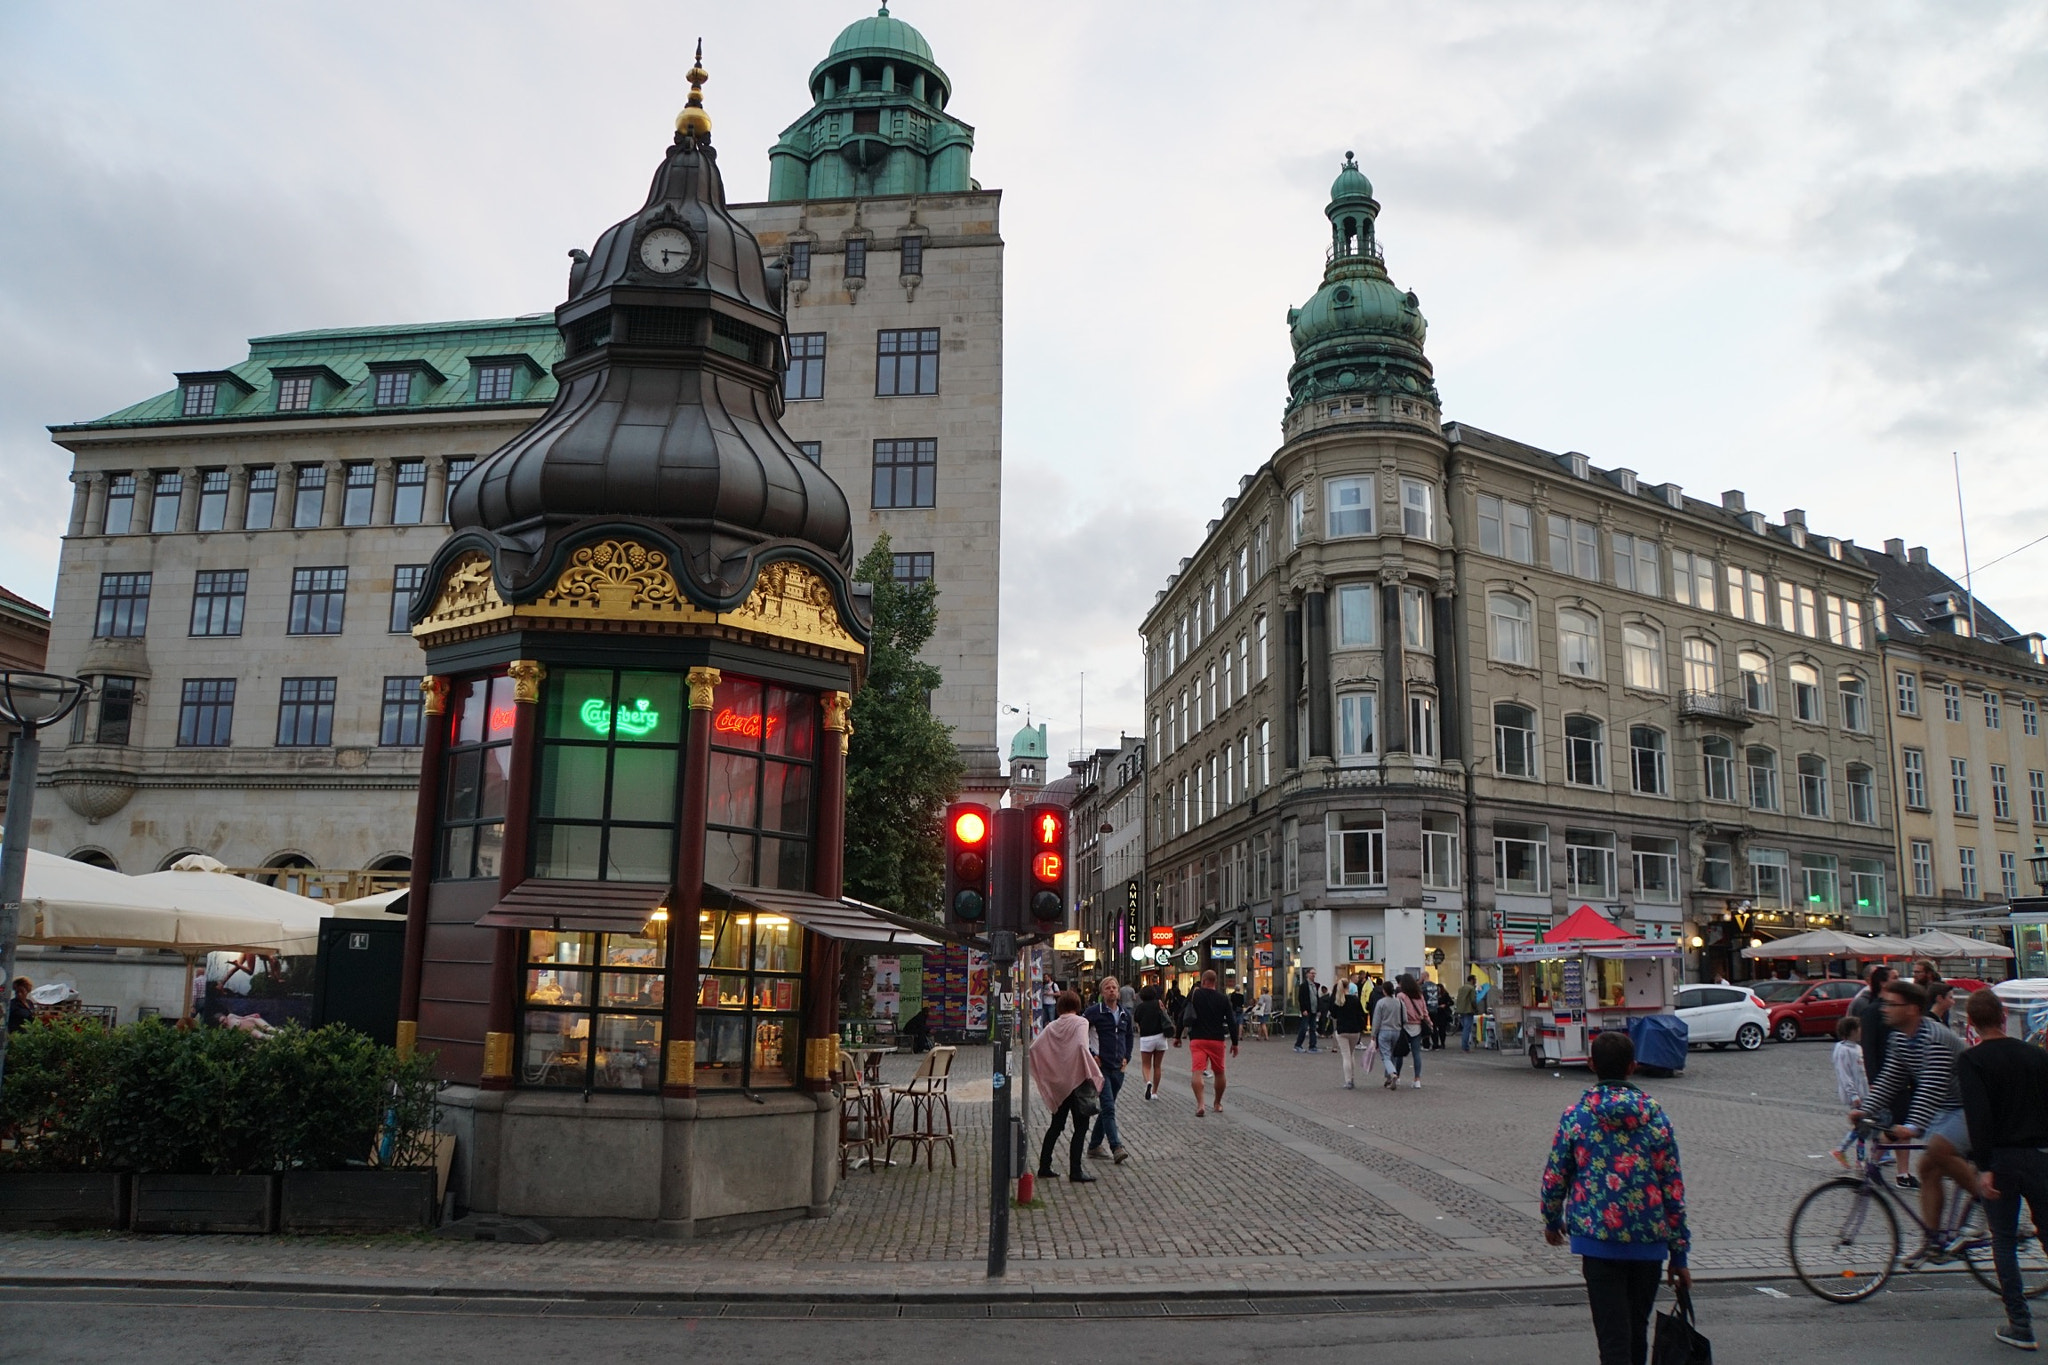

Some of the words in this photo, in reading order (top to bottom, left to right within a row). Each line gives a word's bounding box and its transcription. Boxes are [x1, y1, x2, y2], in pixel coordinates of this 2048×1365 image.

[581, 699, 659, 731] Carsberg
[1043, 856, 1058, 877] 12
[1129, 882, 1137, 942] AMAZING
[1152, 932, 1173, 940] SCOOP
